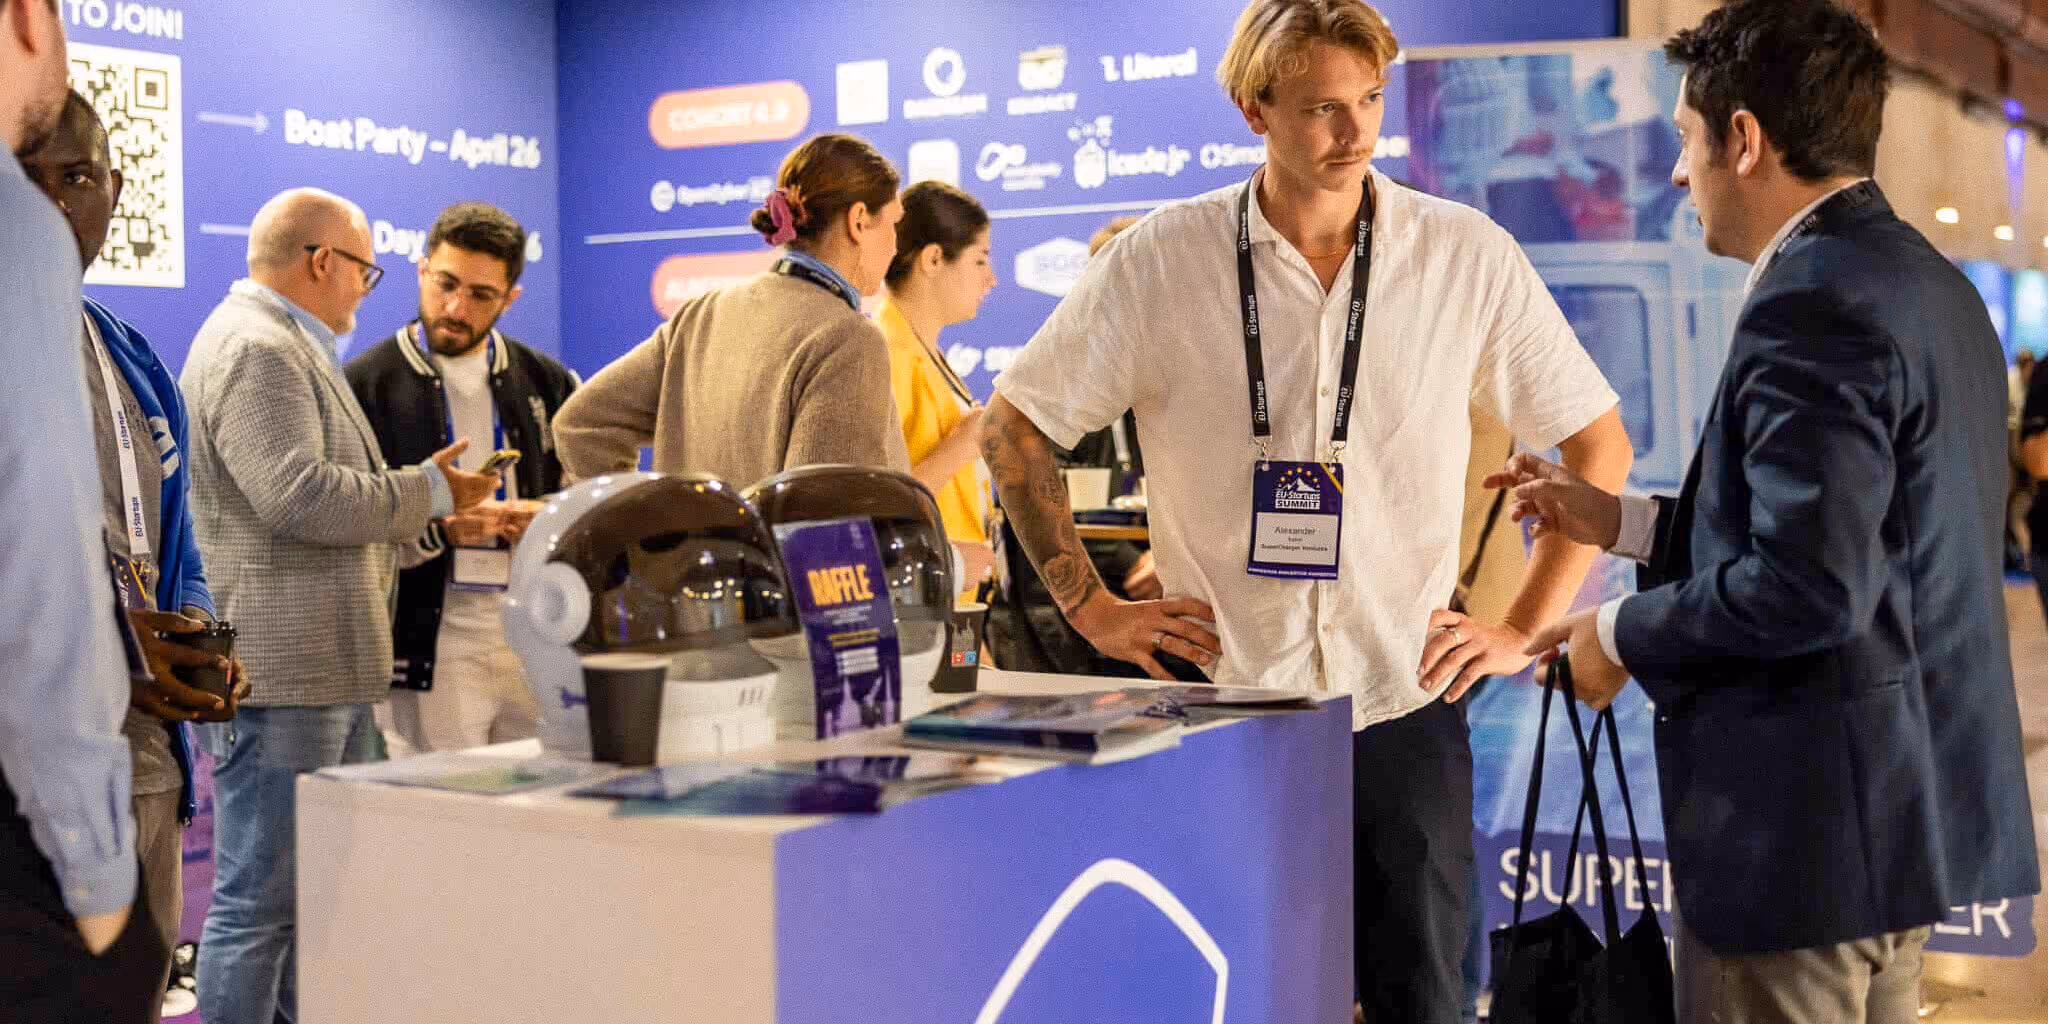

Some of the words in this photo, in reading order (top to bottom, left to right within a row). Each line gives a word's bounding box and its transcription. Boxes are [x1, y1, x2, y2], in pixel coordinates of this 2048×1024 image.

[66, 0, 108, 28] TO
[111, 0, 183, 40] JOIN!
[284, 108, 353, 150] Boat
[354, 117, 428, 165] Party
[450, 128, 509, 170] April
[509, 134, 541, 170] 26
[372, 219, 426, 264] Day
[1275, 499, 1321, 510] SUMMIT
[1274, 526, 1317, 536] Alexander
[807, 563, 874, 607] RAFFLE
